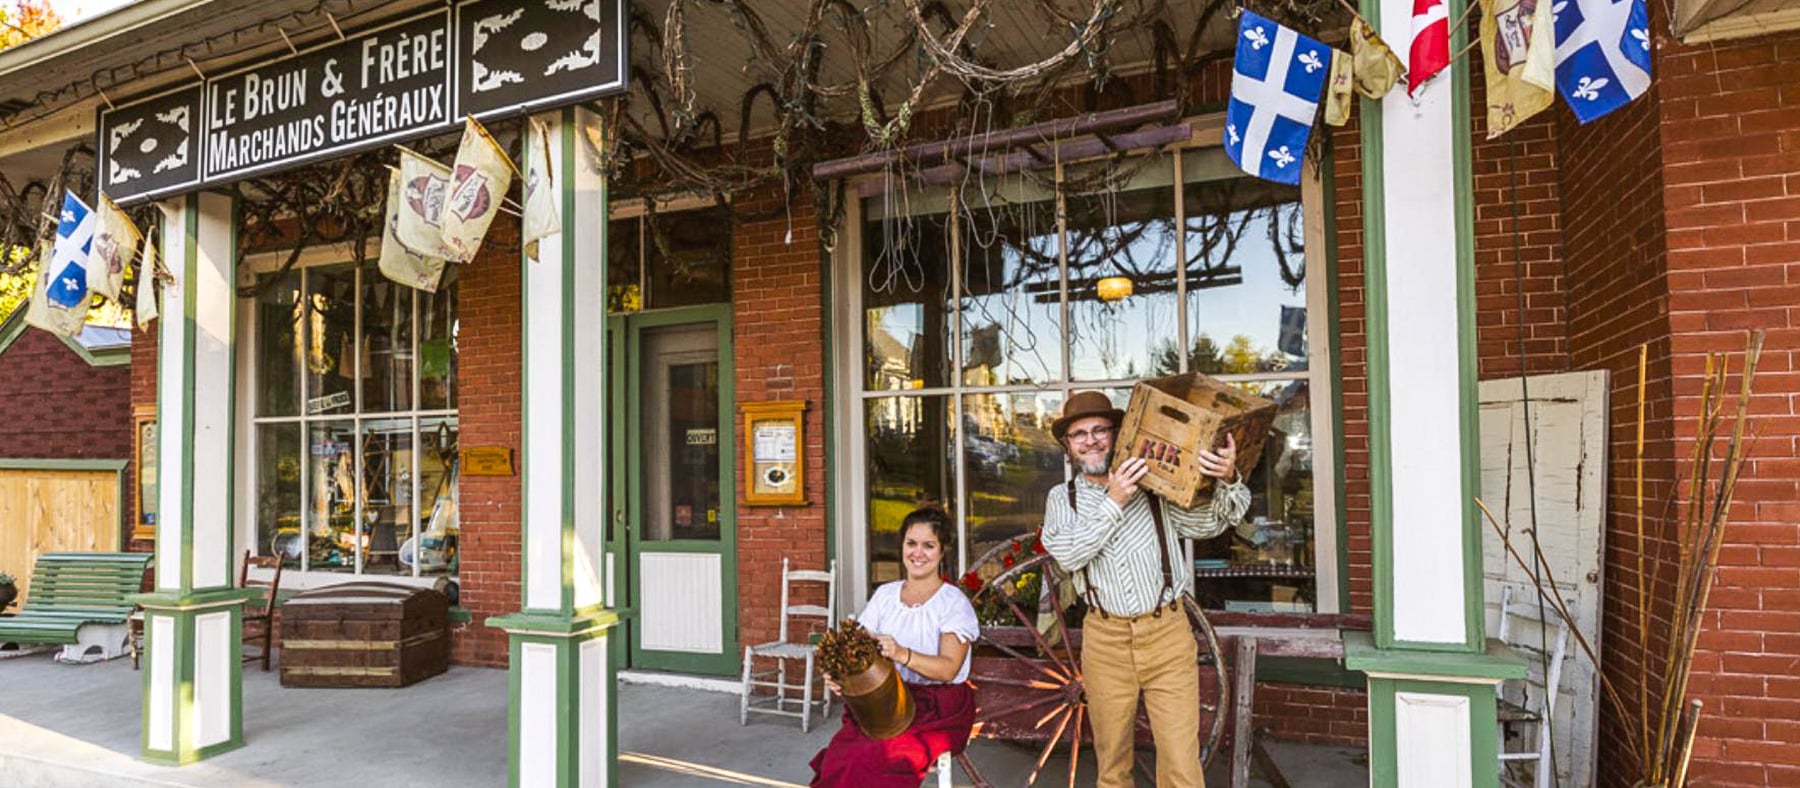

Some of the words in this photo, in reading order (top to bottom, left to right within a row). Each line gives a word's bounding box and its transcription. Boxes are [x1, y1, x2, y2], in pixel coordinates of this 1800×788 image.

[243, 68, 307, 121] BRUN
[321, 58, 345, 98] &
[361, 28, 444, 89] FRÈRE
[208, 114, 325, 173] MARCHANDS
[330, 83, 443, 143] GÉNÉRAUX
[1139, 438, 1182, 467] KIK
